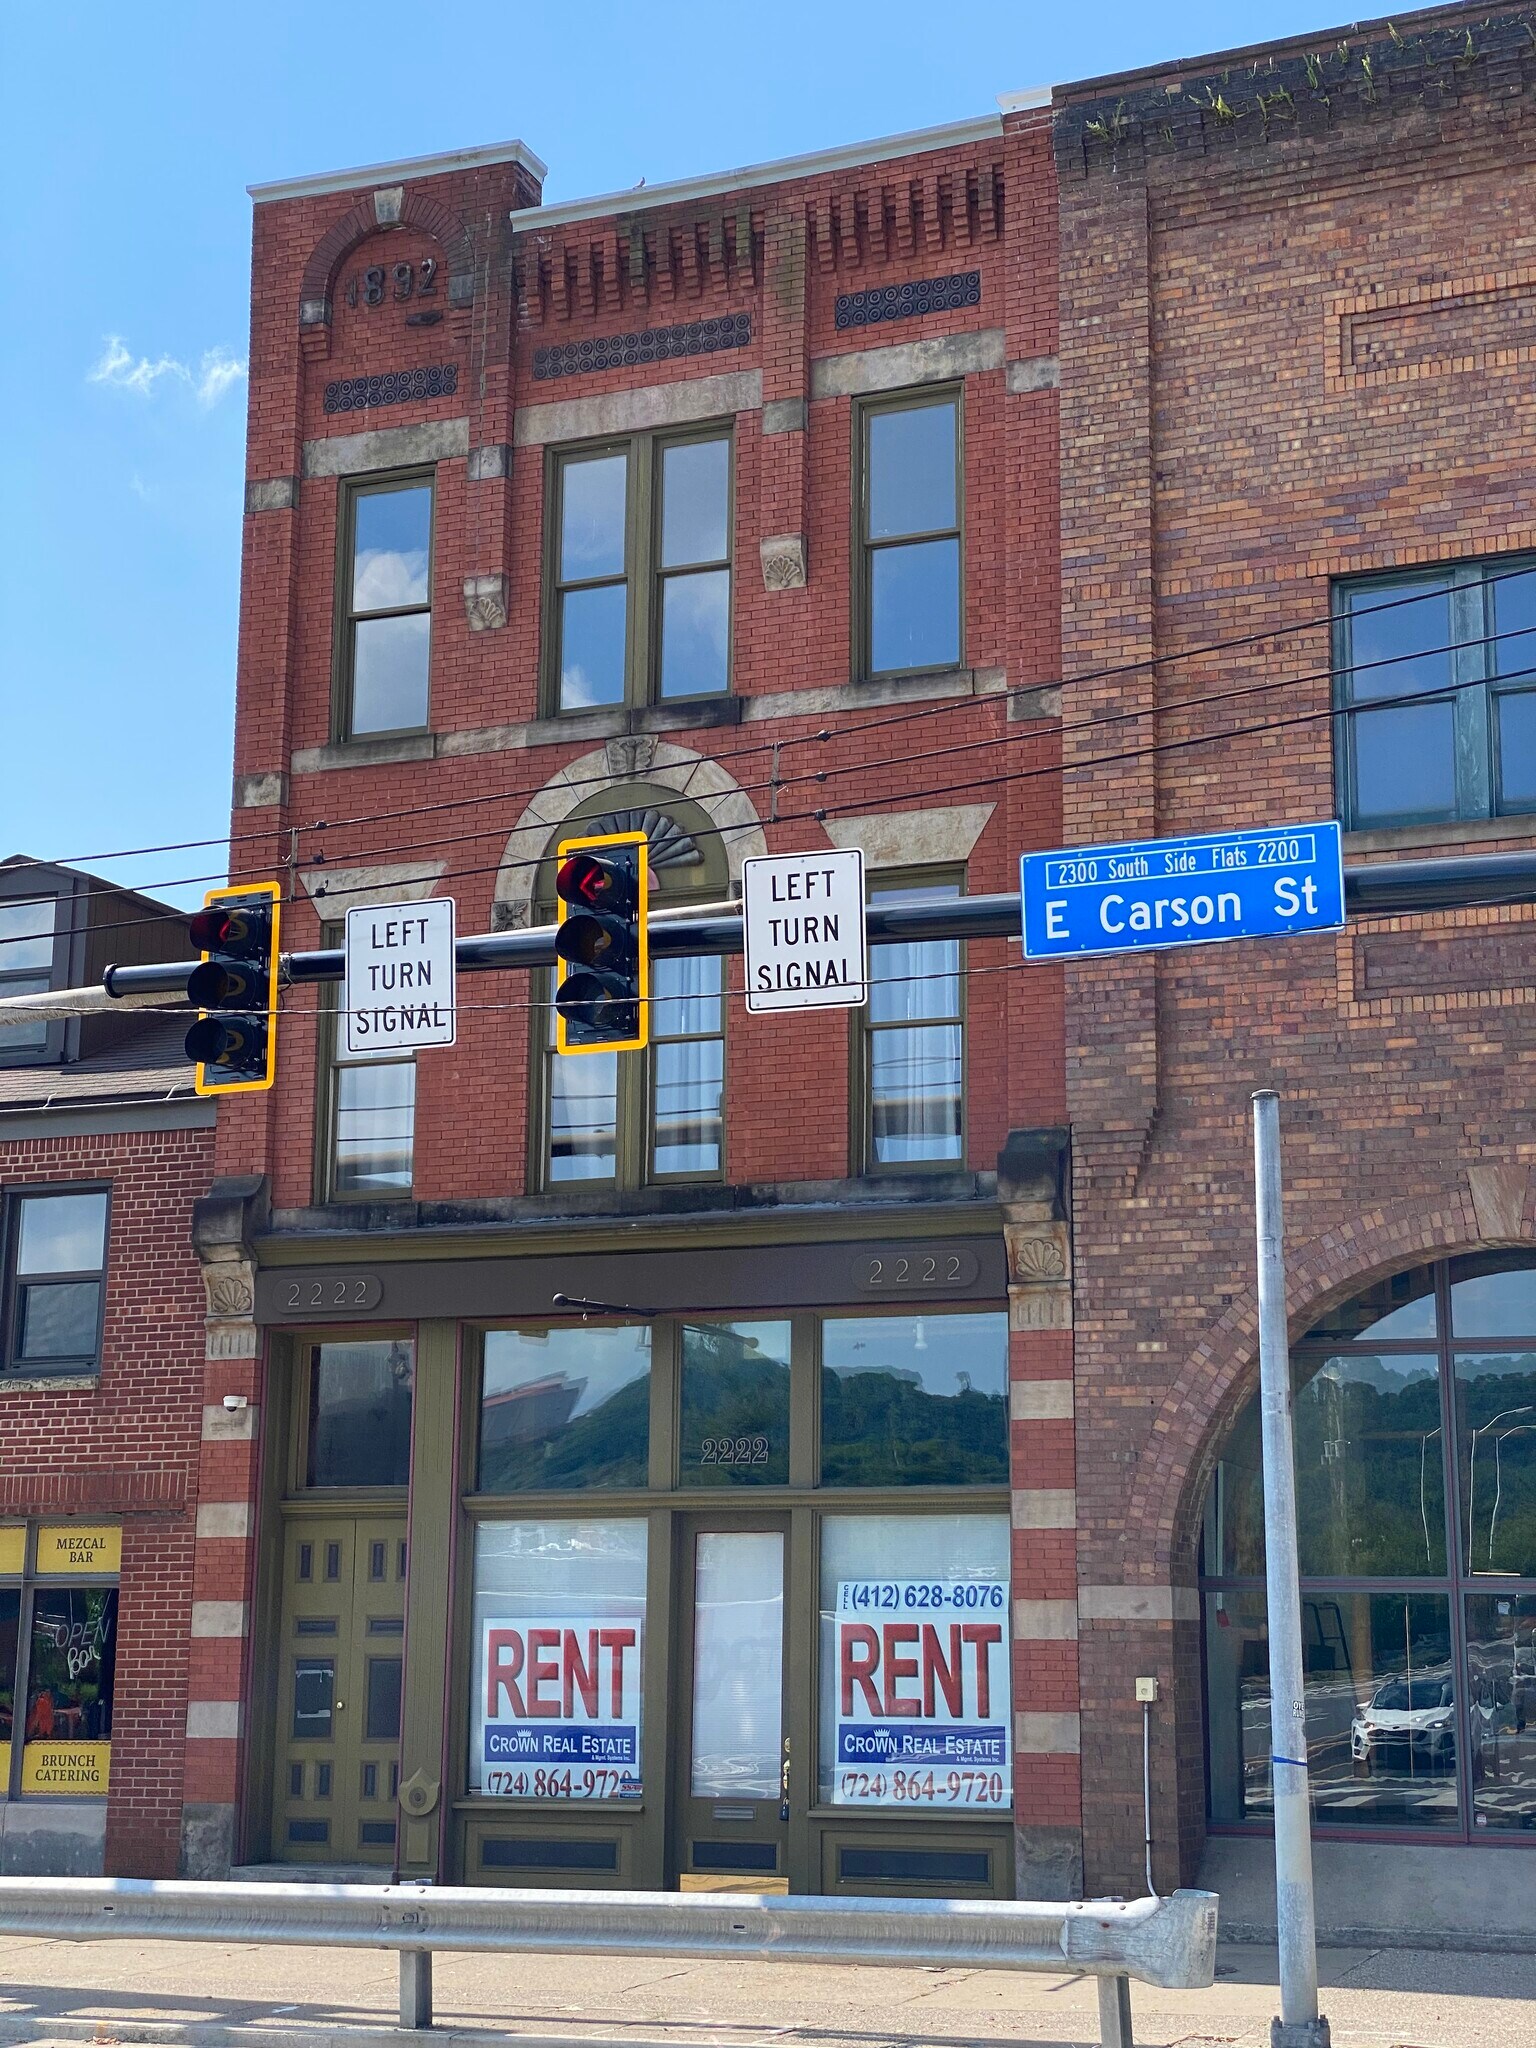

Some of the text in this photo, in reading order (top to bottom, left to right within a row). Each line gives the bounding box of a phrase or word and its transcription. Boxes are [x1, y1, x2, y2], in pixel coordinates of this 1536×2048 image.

[346, 258, 437, 308] 1892
[1058, 839, 1300, 885] 2300 South Side Flats 2200
[771, 869, 835, 902] LEFT
[1045, 875, 1319, 939] E Carson St
[371, 918, 429, 949] LEFT
[768, 914, 839, 946] TURN
[368, 960, 431, 991] TURN
[757, 958, 847, 990] SIGNAL
[356, 1001, 446, 1034] SIGNAL
[868, 1256, 960, 1284] 2222
[287, 1281, 367, 1306] 2222
[700, 1437, 769, 1465] 2222
[55, 1537, 106, 1550] MEZCAL
[69, 1551, 94, 1563] BAR
[852, 1584, 1003, 1609] (412) 628-8076
[55, 1617, 111, 1648] OPEN
[487, 1628, 636, 1719] RENT
[840, 1623, 1002, 1719] RENT
[489, 1734, 631, 1754] CROWN REAL ESTATE
[844, 1734, 1000, 1755] CROWN REAL ESTATE
[35, 1769, 100, 1782] CATERING
[41, 1754, 96, 1767] BRUNCH
[488, 1772, 529, 1795] (724)
[841, 1770, 1003, 1803] (724) 864-9720
